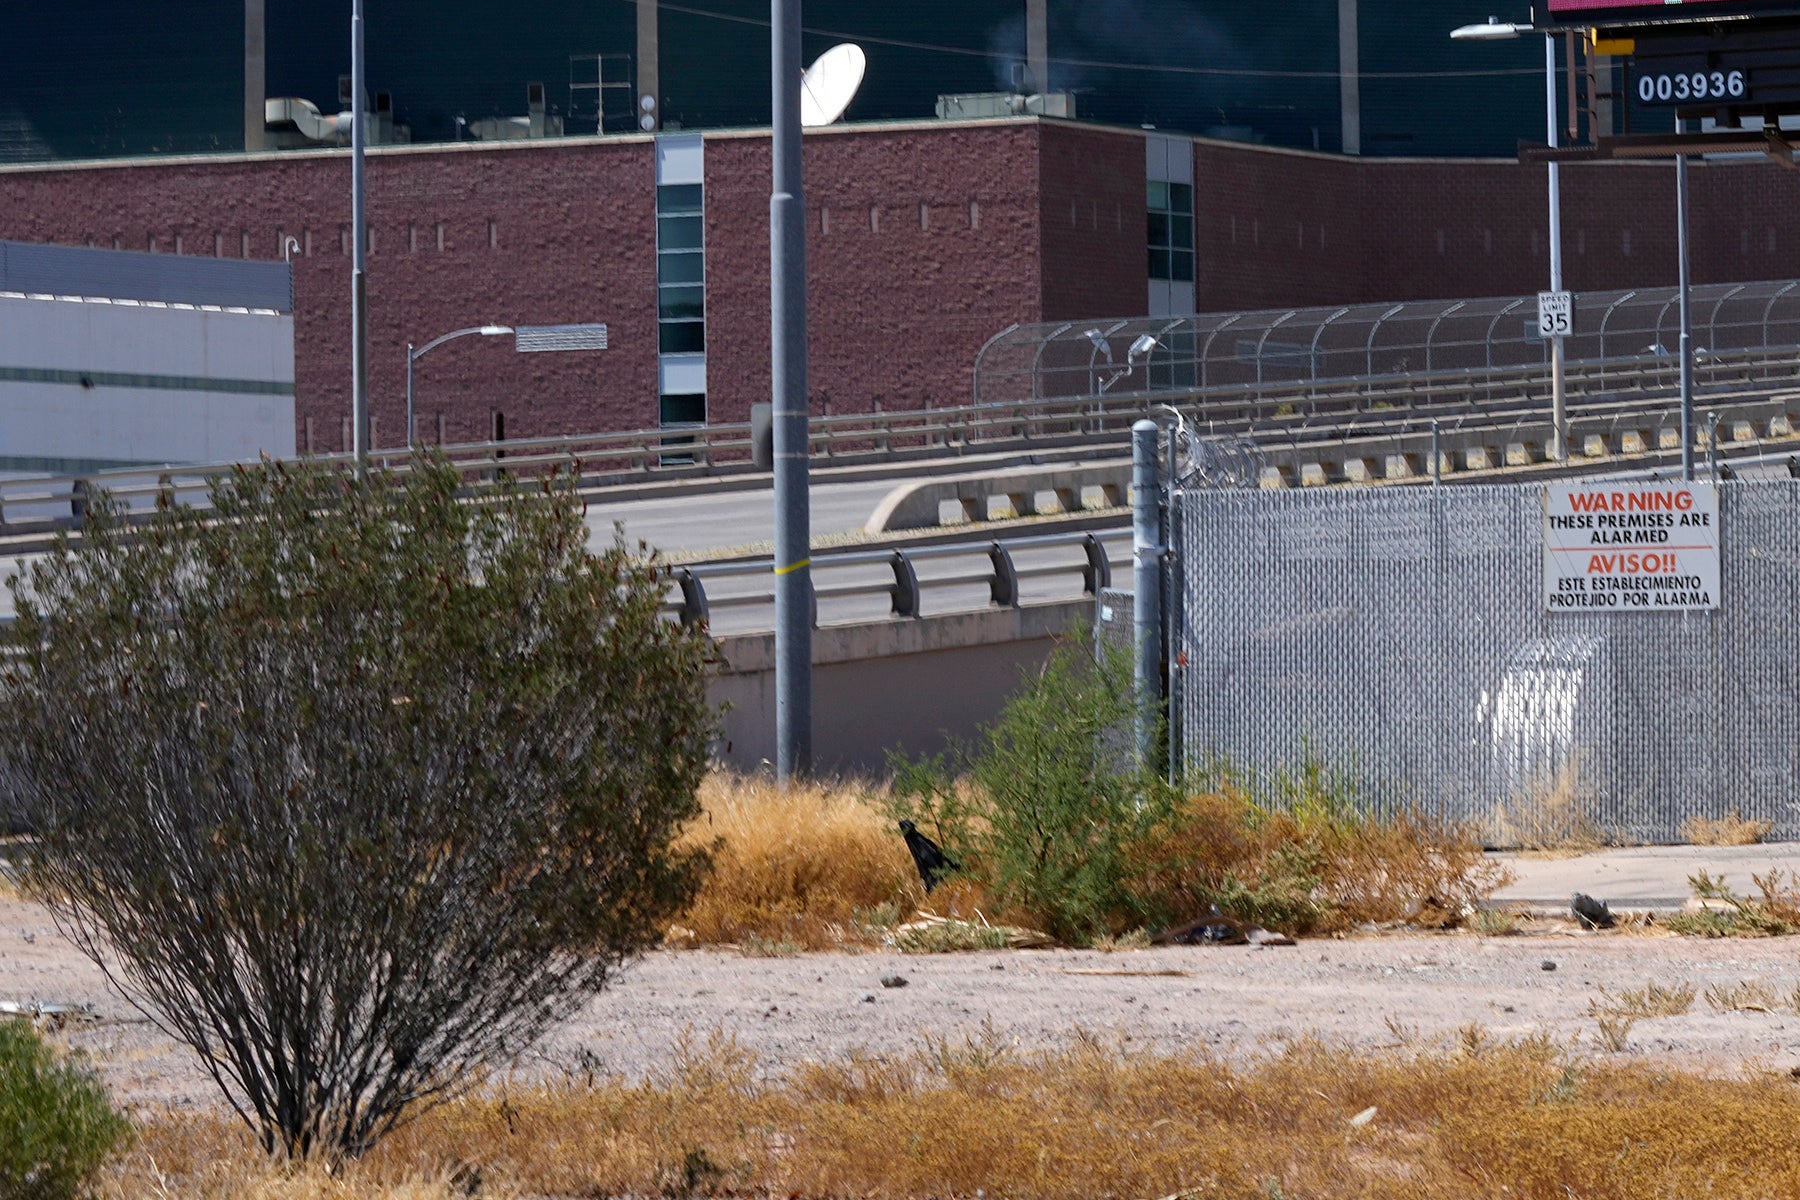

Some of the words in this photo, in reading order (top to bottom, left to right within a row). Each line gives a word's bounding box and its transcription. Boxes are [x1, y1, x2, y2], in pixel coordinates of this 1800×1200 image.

[1638, 70, 1745, 102] 003936
[1541, 294, 1569, 304] SPEED
[1543, 303, 1567, 312] LIMIT
[1542, 313, 1568, 332] 35
[1568, 491, 1694, 512] WARNING
[1549, 515, 1594, 529] THESE
[1598, 513, 1674, 528] PREMISES
[1680, 512, 1710, 527] ARE
[1591, 529, 1668, 544] ALARMED
[1587, 553, 1676, 574] AVISO!!
[1558, 577, 1585, 591] ESTE
[1592, 576, 1701, 590] ESTABLECIMIENTO
[1550, 593, 1617, 607] PROTEJIDO
[1624, 592, 1649, 606] POR
[1654, 591, 1711, 606] ALARMA
